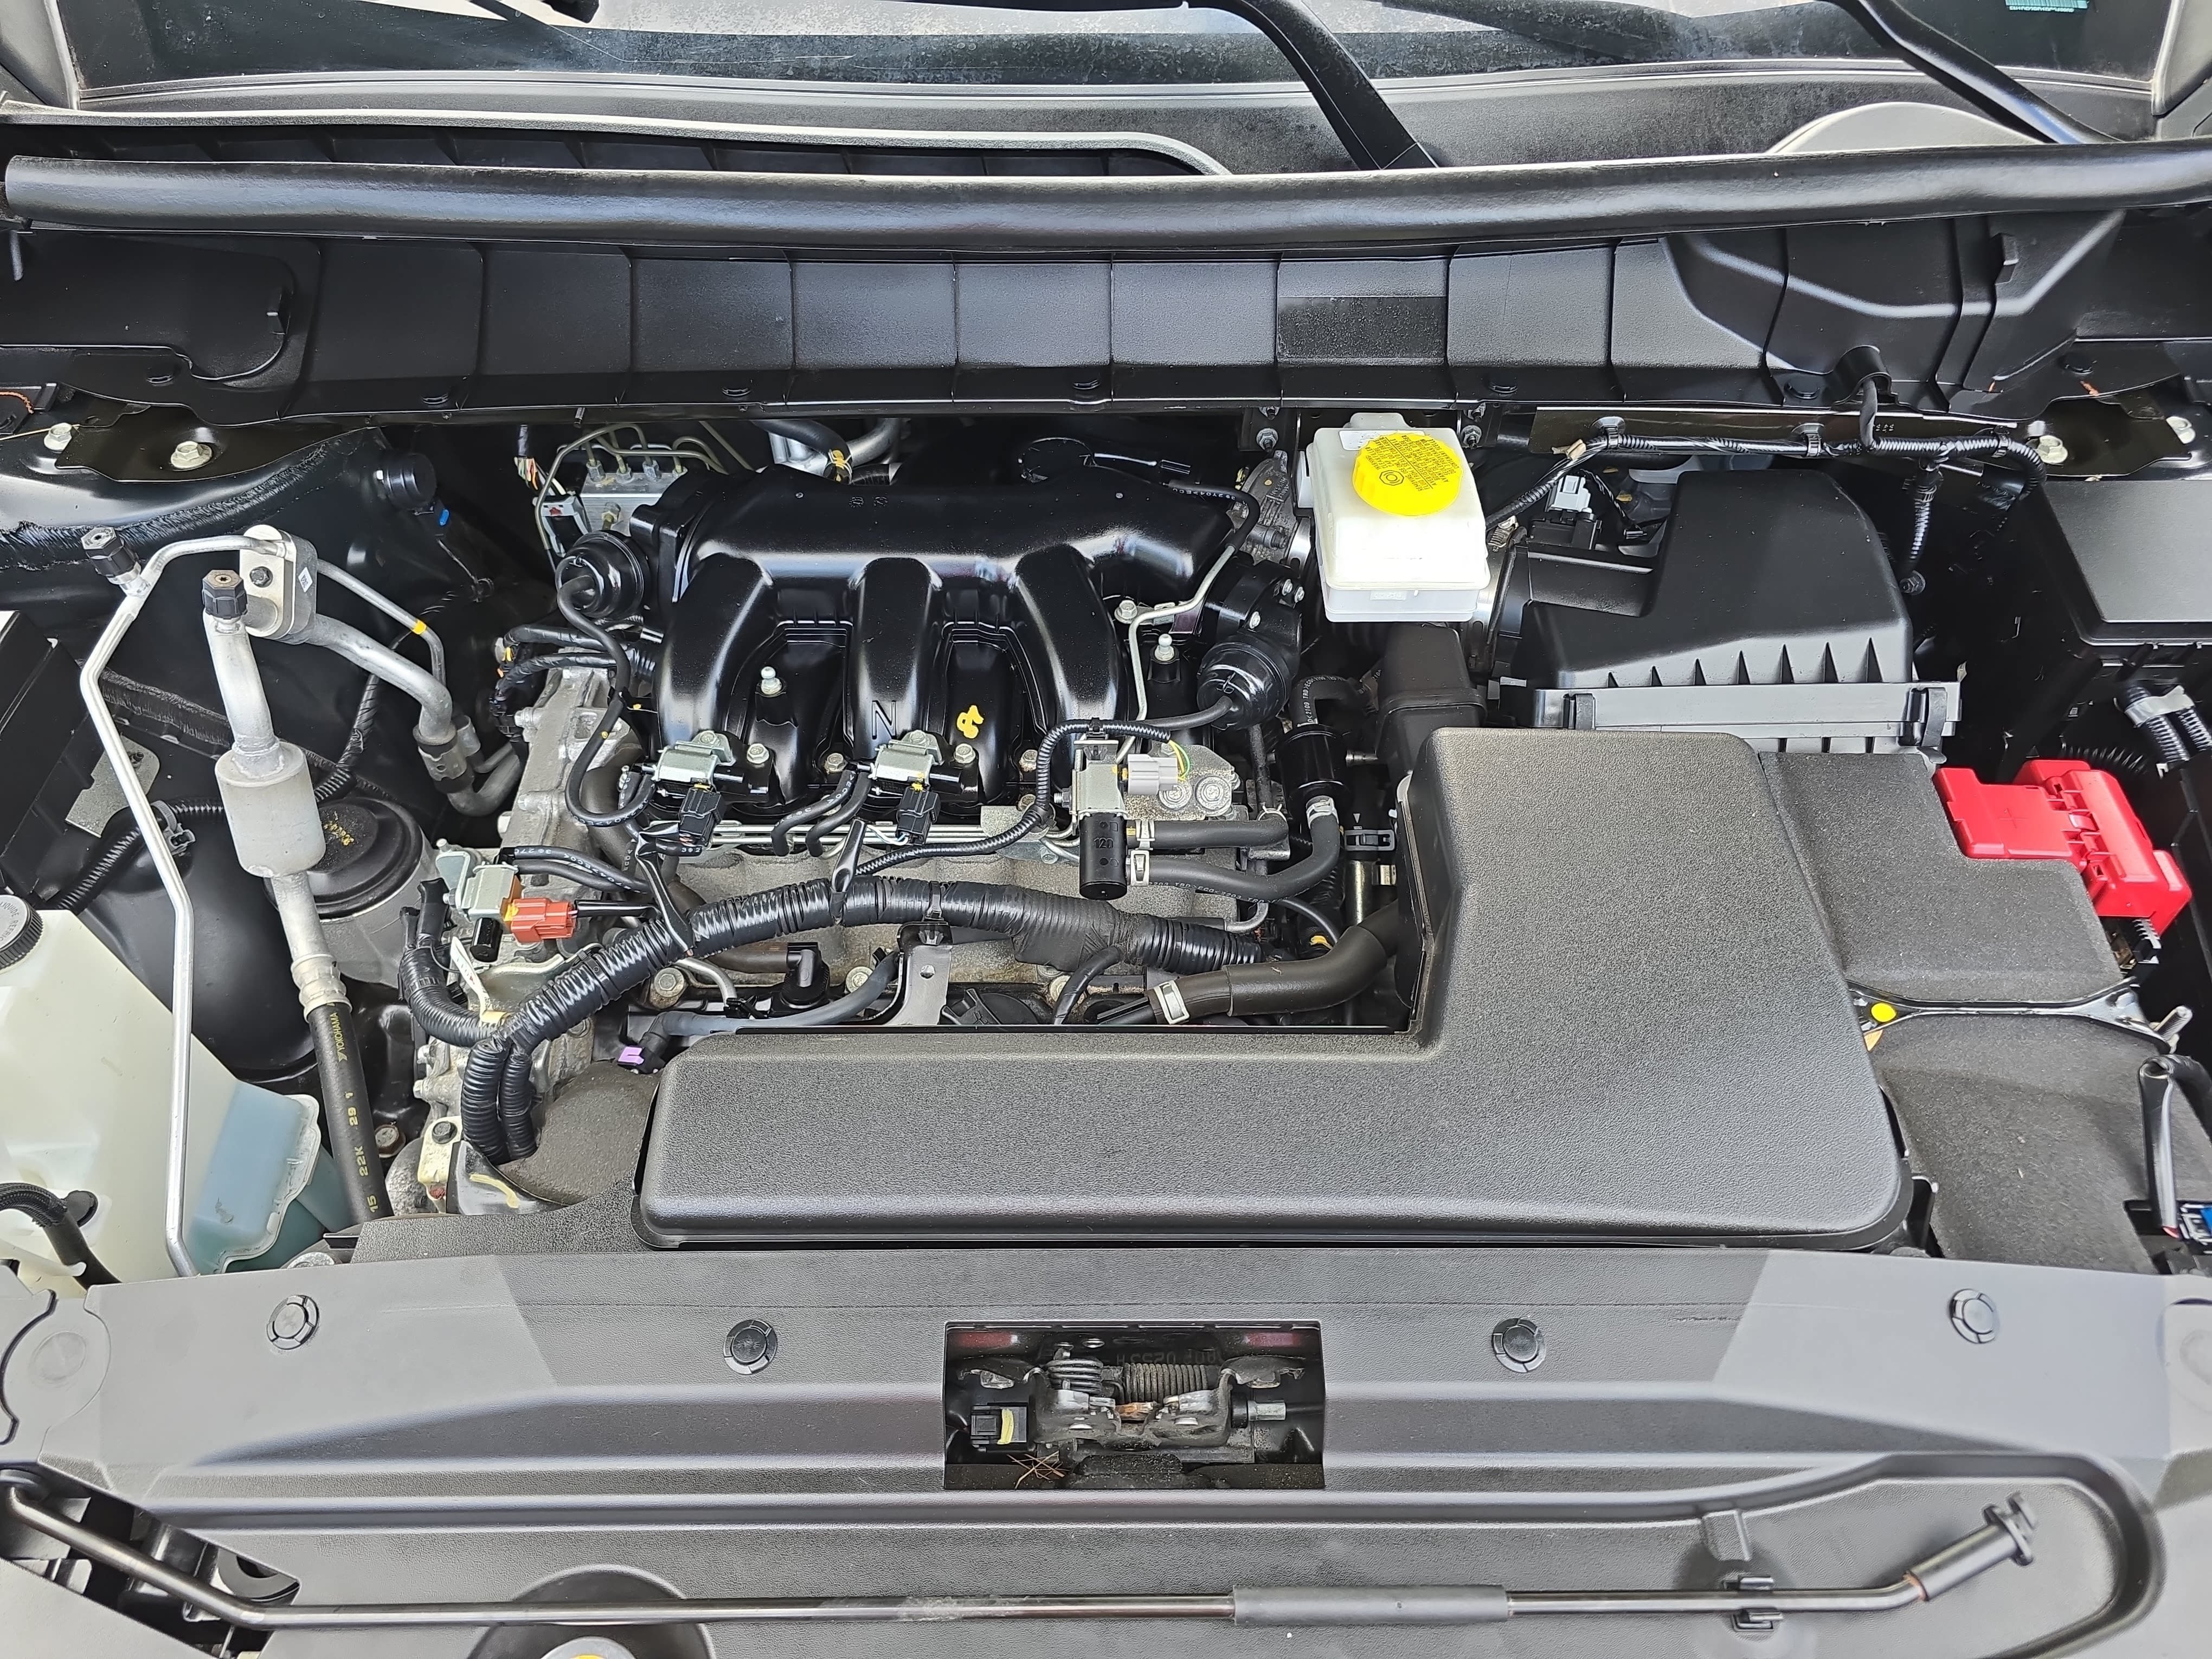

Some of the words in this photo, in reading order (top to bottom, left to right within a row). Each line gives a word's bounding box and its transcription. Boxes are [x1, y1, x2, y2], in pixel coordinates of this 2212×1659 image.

[329, 1012, 345, 1051] YOKOHAMA
[348, 1107, 359, 1127] 29
[354, 1146, 369, 1176] 22K
[366, 1195, 378, 1213] 15
